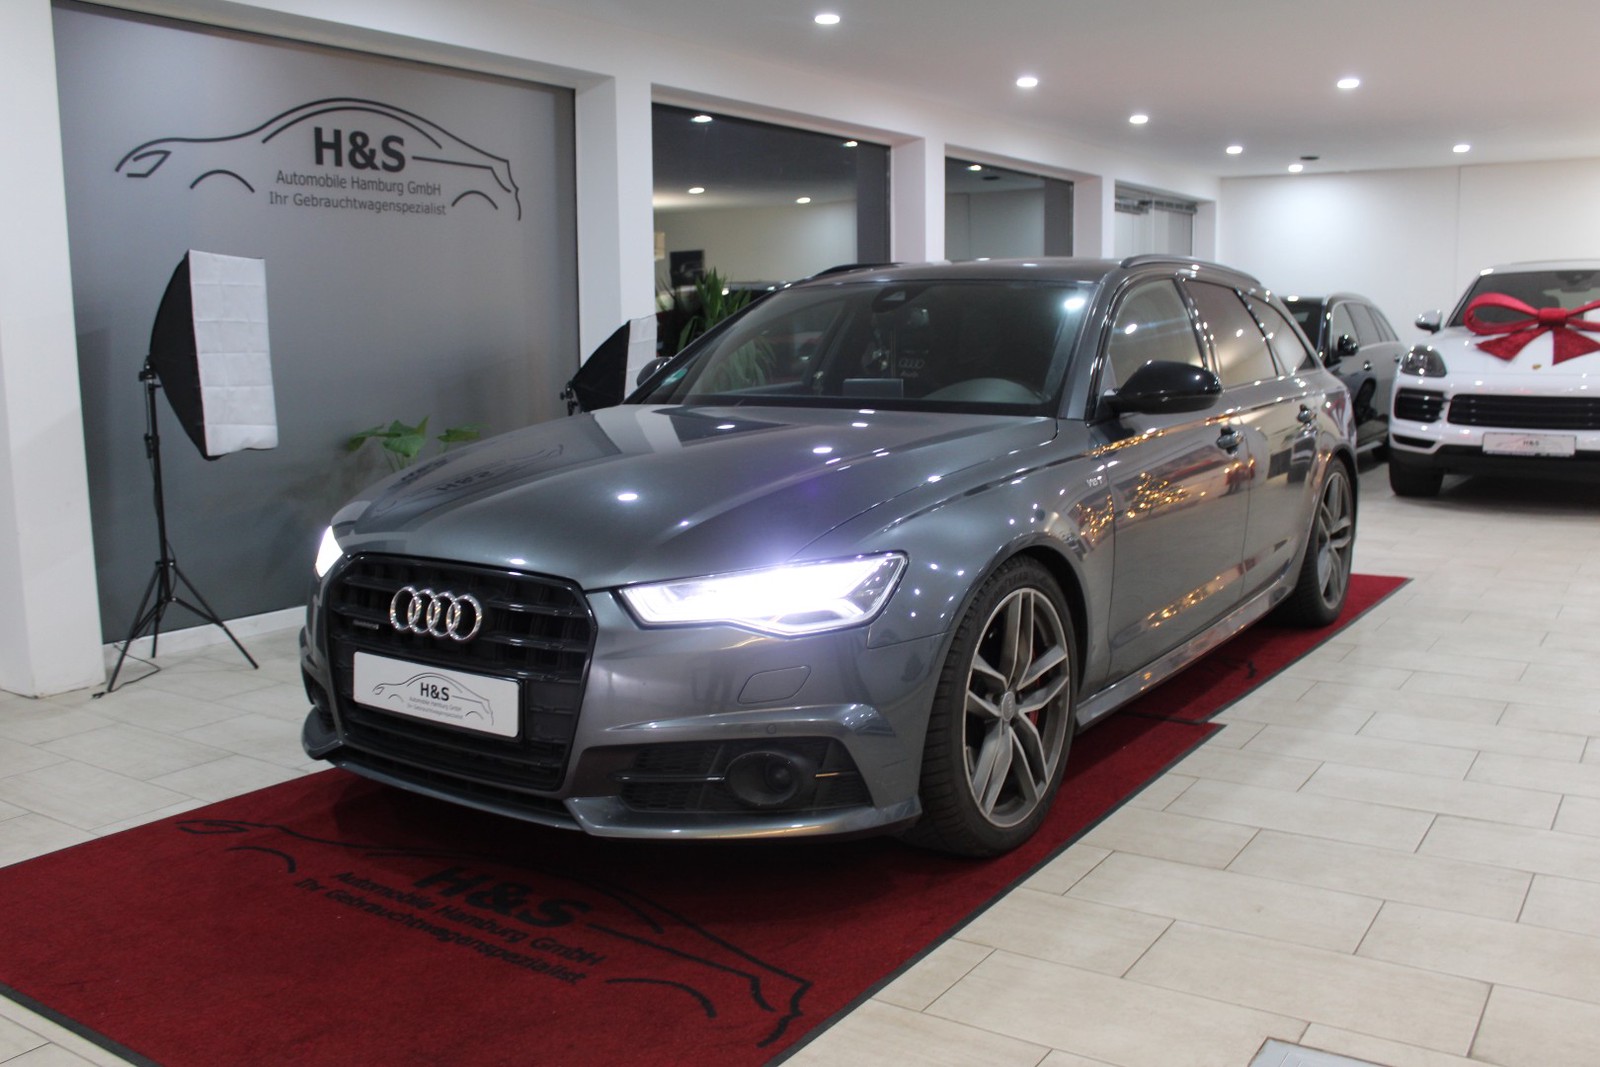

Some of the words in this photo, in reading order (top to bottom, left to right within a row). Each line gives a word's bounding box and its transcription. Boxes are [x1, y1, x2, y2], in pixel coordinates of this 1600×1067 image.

[314, 126, 406, 173] H&S
[269, 191, 289, 205] Ihr
[293, 193, 446, 215] Gebrauchtwagenspezialist
[276, 170, 347, 189] Automobile
[351, 176, 404, 196] Hamburg
[407, 181, 441, 196] GmbH
[420, 682, 450, 702] H&S
[331, 872, 436, 911] Automobile
[433, 905, 531, 943] Hamburg
[530, 937, 606, 966] GmbH
[413, 867, 592, 928] H&S
[324, 889, 588, 985] Gebrauchtwagenspezialist
